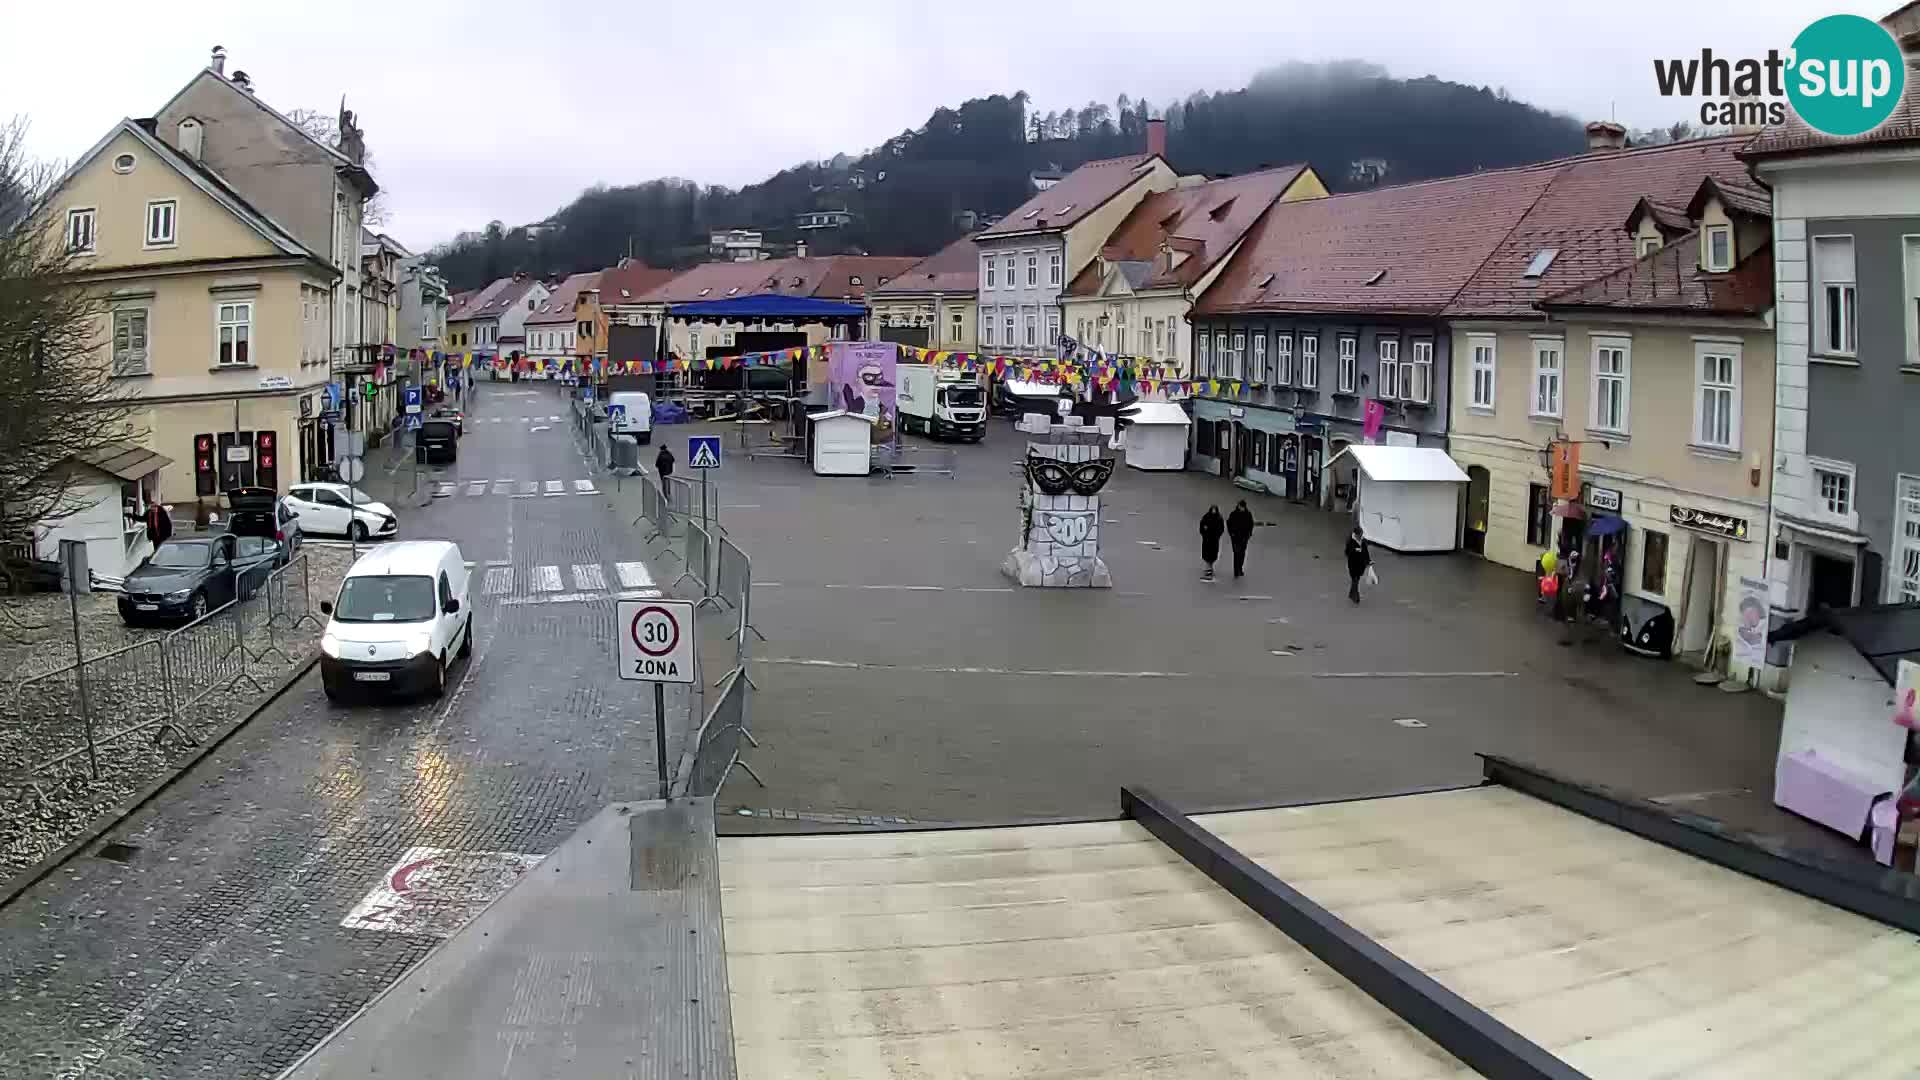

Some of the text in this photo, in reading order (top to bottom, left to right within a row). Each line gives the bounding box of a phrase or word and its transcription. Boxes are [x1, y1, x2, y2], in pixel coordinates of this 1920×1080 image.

[409, 391, 416, 403] P
[644, 622, 668, 643] 30
[634, 659, 679, 677] ZONA
